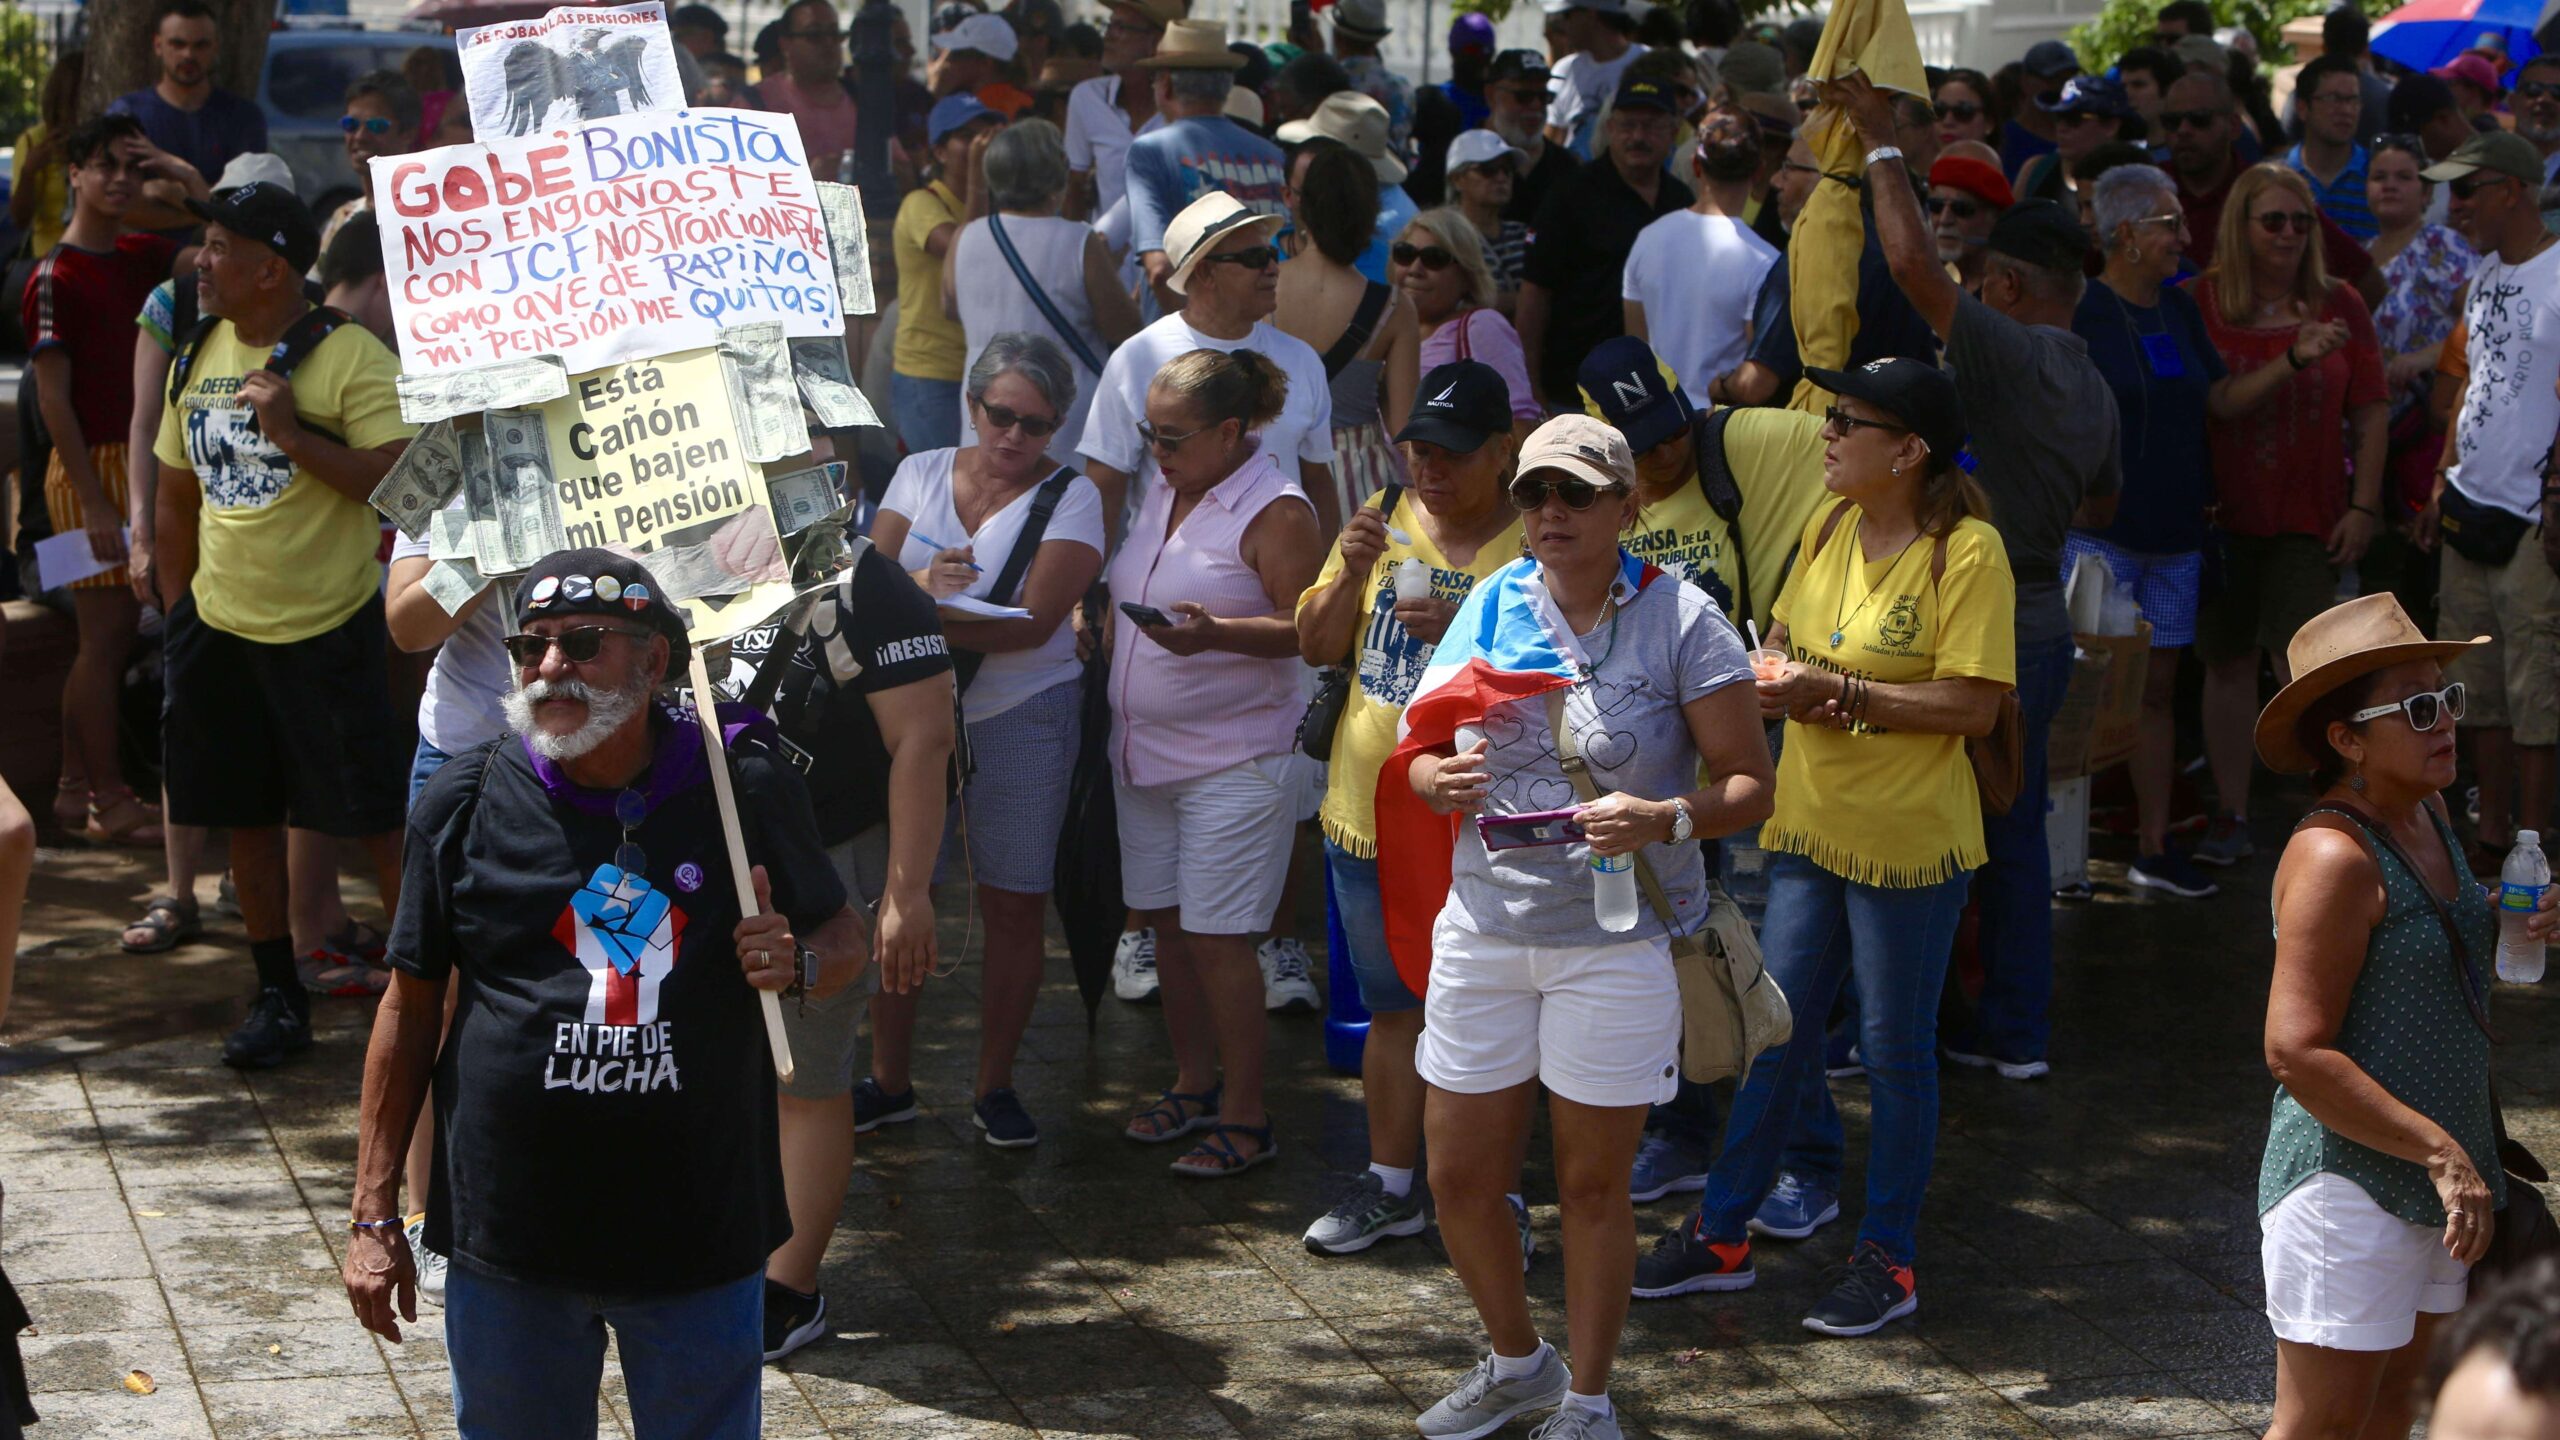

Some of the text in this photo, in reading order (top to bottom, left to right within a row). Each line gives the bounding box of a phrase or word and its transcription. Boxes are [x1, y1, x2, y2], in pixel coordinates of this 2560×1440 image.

[475, 32, 491, 45] SE
[548, 13, 574, 31] LAS
[577, 10, 659, 26] PENSIONES
[402, 219, 492, 272] NOS
[404, 259, 482, 304] CON
[490, 224, 589, 295] JCF
[631, 296, 683, 325] ME
[2517, 298, 2534, 342] RICO
[200, 377, 245, 395] DEFEN
[579, 359, 664, 411] Está
[1427, 400, 1454, 409] NAUTICA
[1613, 371, 1649, 407] N
[569, 398, 700, 461] Cañón
[559, 437, 729, 511] que bajen
[566, 511, 608, 550] mi
[614, 476, 743, 543] Pensión
[1682, 533, 1695, 546] DE
[1697, 530, 1711, 542] LA
[555, 1021, 673, 1056] EN PIE DE
[544, 1053, 681, 1094] LUCHA
